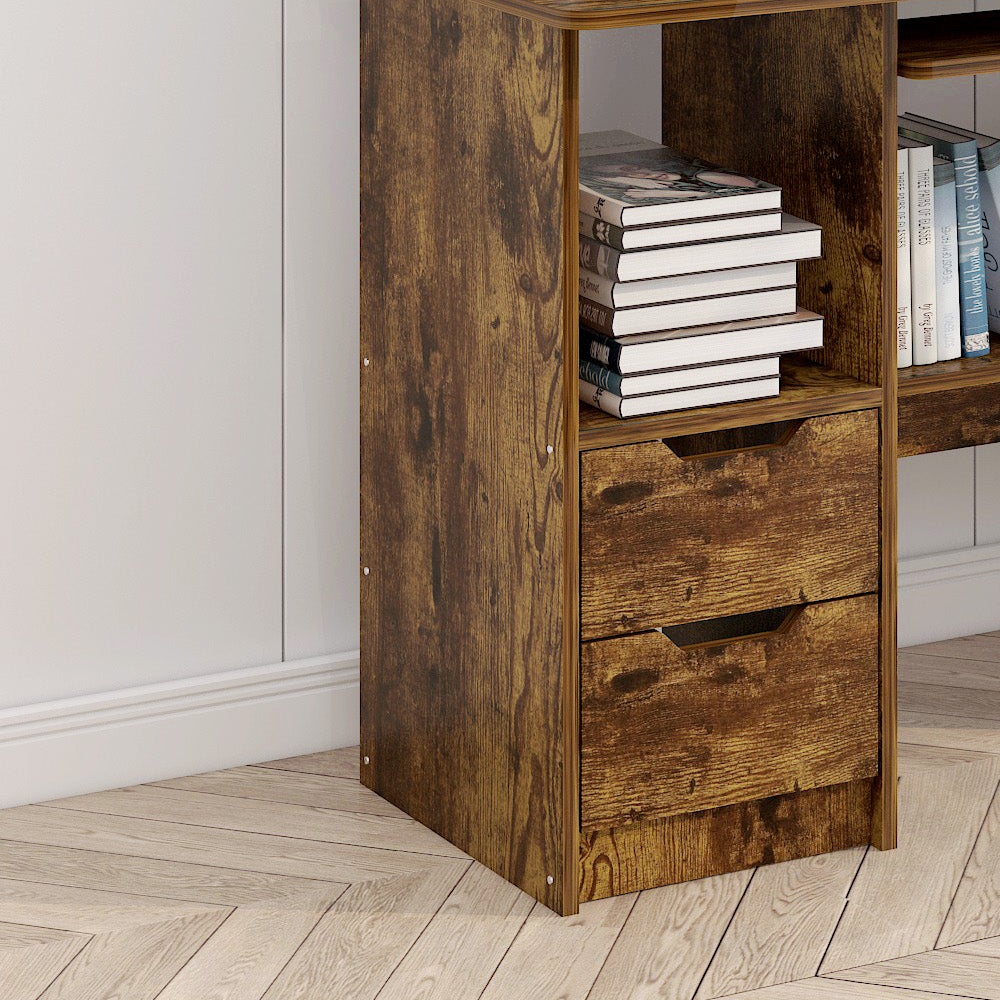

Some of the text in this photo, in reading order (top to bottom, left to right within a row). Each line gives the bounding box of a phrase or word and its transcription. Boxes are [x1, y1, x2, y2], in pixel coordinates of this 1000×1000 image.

[917, 168, 932, 246] THREE PAIRS OF GLASSES
[953, 154, 985, 314] the lovely bones alice sebold
[918, 302, 933, 347] by Greg Bennet
